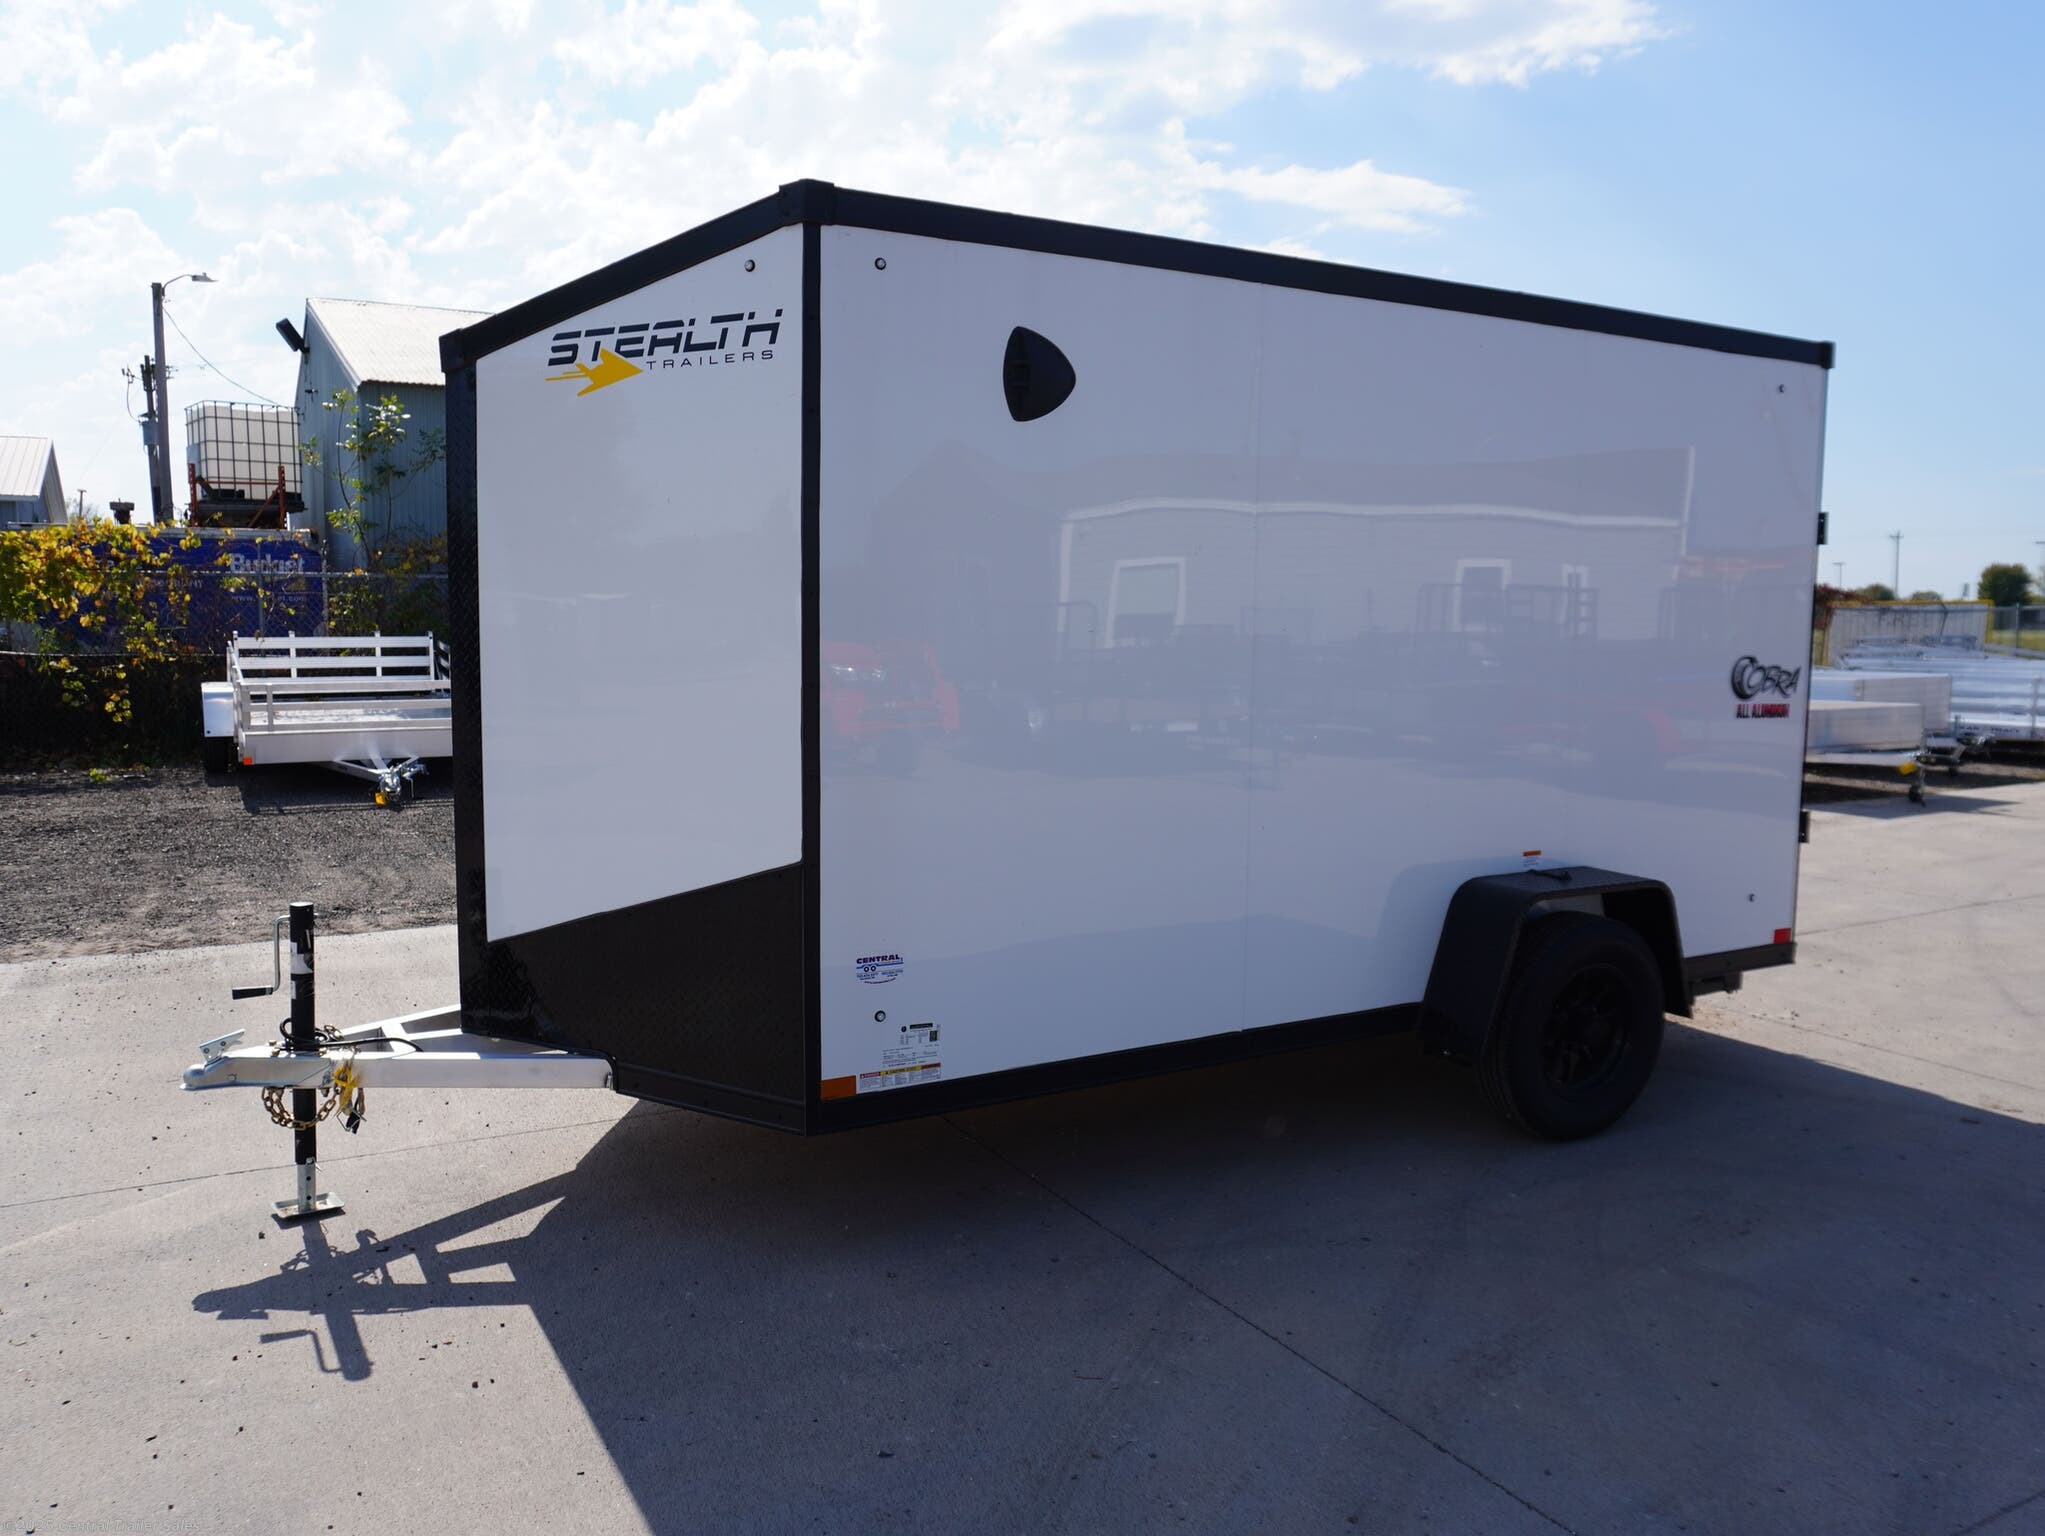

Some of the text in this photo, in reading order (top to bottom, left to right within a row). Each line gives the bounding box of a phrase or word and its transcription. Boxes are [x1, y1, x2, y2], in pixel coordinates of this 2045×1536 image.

[548, 308, 784, 367] STEALTH
[646, 350, 774, 371] TRAILERS
[1736, 703, 1750, 719] ALL
[856, 953, 901, 965] CENTRAL
